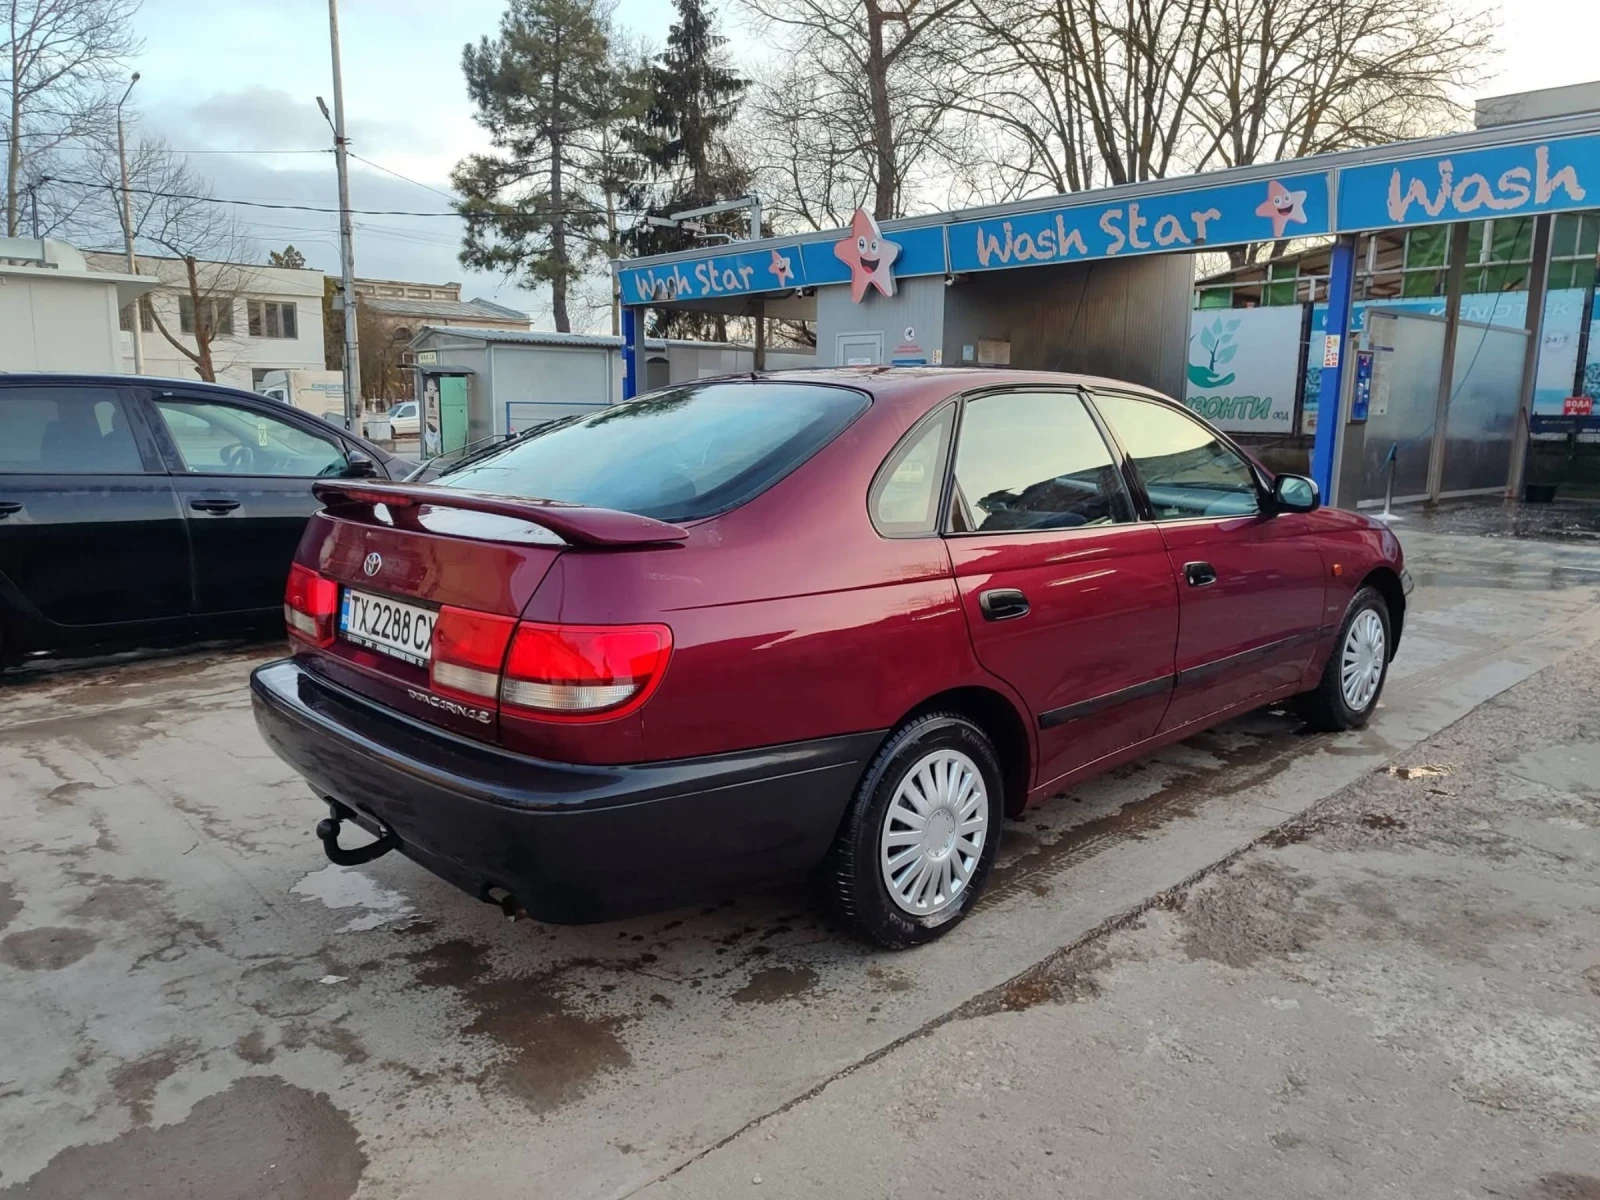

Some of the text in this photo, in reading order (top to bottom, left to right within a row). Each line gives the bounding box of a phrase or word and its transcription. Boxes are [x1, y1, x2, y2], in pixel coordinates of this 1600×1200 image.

[1387, 145, 1586, 222] Wash
[977, 202, 1222, 267] Wash Star
[695, 260, 754, 295] Star
